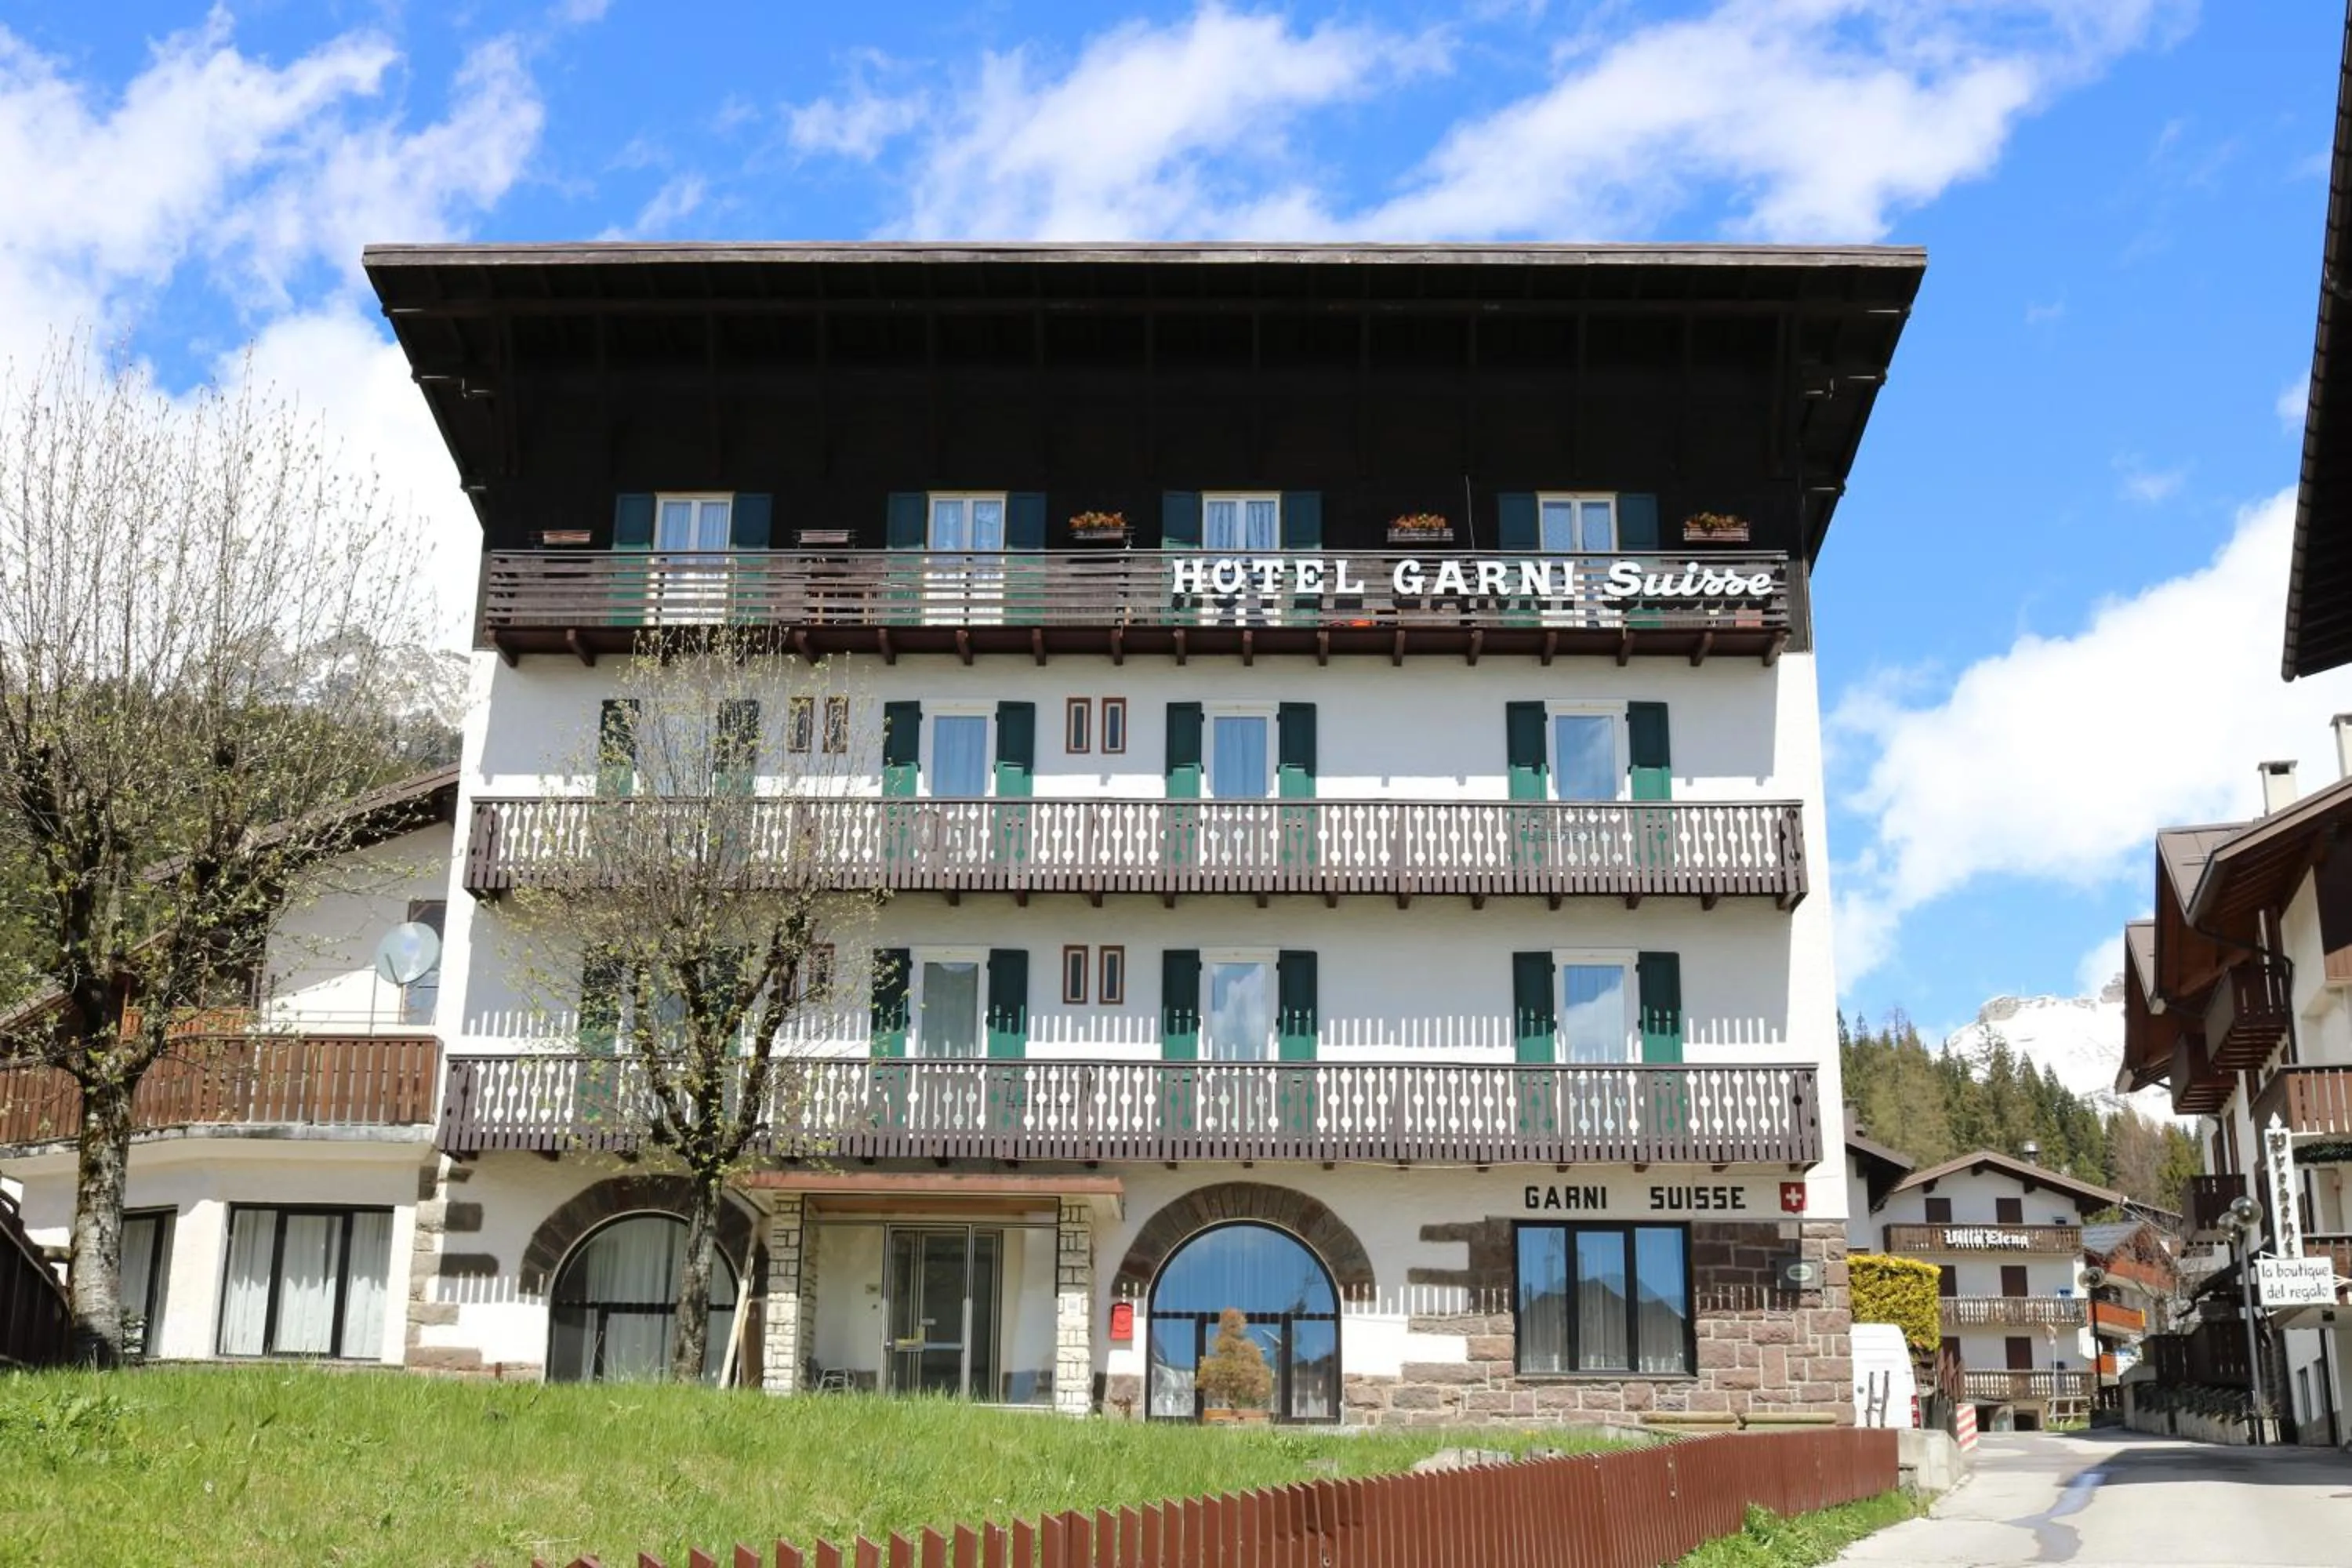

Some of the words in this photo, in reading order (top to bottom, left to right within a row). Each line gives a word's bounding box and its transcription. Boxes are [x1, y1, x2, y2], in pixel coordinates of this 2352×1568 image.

[1173, 558, 1365, 593] HOTEL
[1392, 559, 1575, 595] GARNI
[1603, 561, 1773, 597] Suisse
[1525, 1186, 1606, 1209] GARNI
[1650, 1186, 1746, 1209] SUISSE
[1944, 1229, 1984, 1245] Villa
[2261, 1264, 2273, 1278] la
[2276, 1262, 2328, 1279] boutique
[2267, 1284, 2285, 1298] del
[2290, 1283, 2328, 1301] regalo
